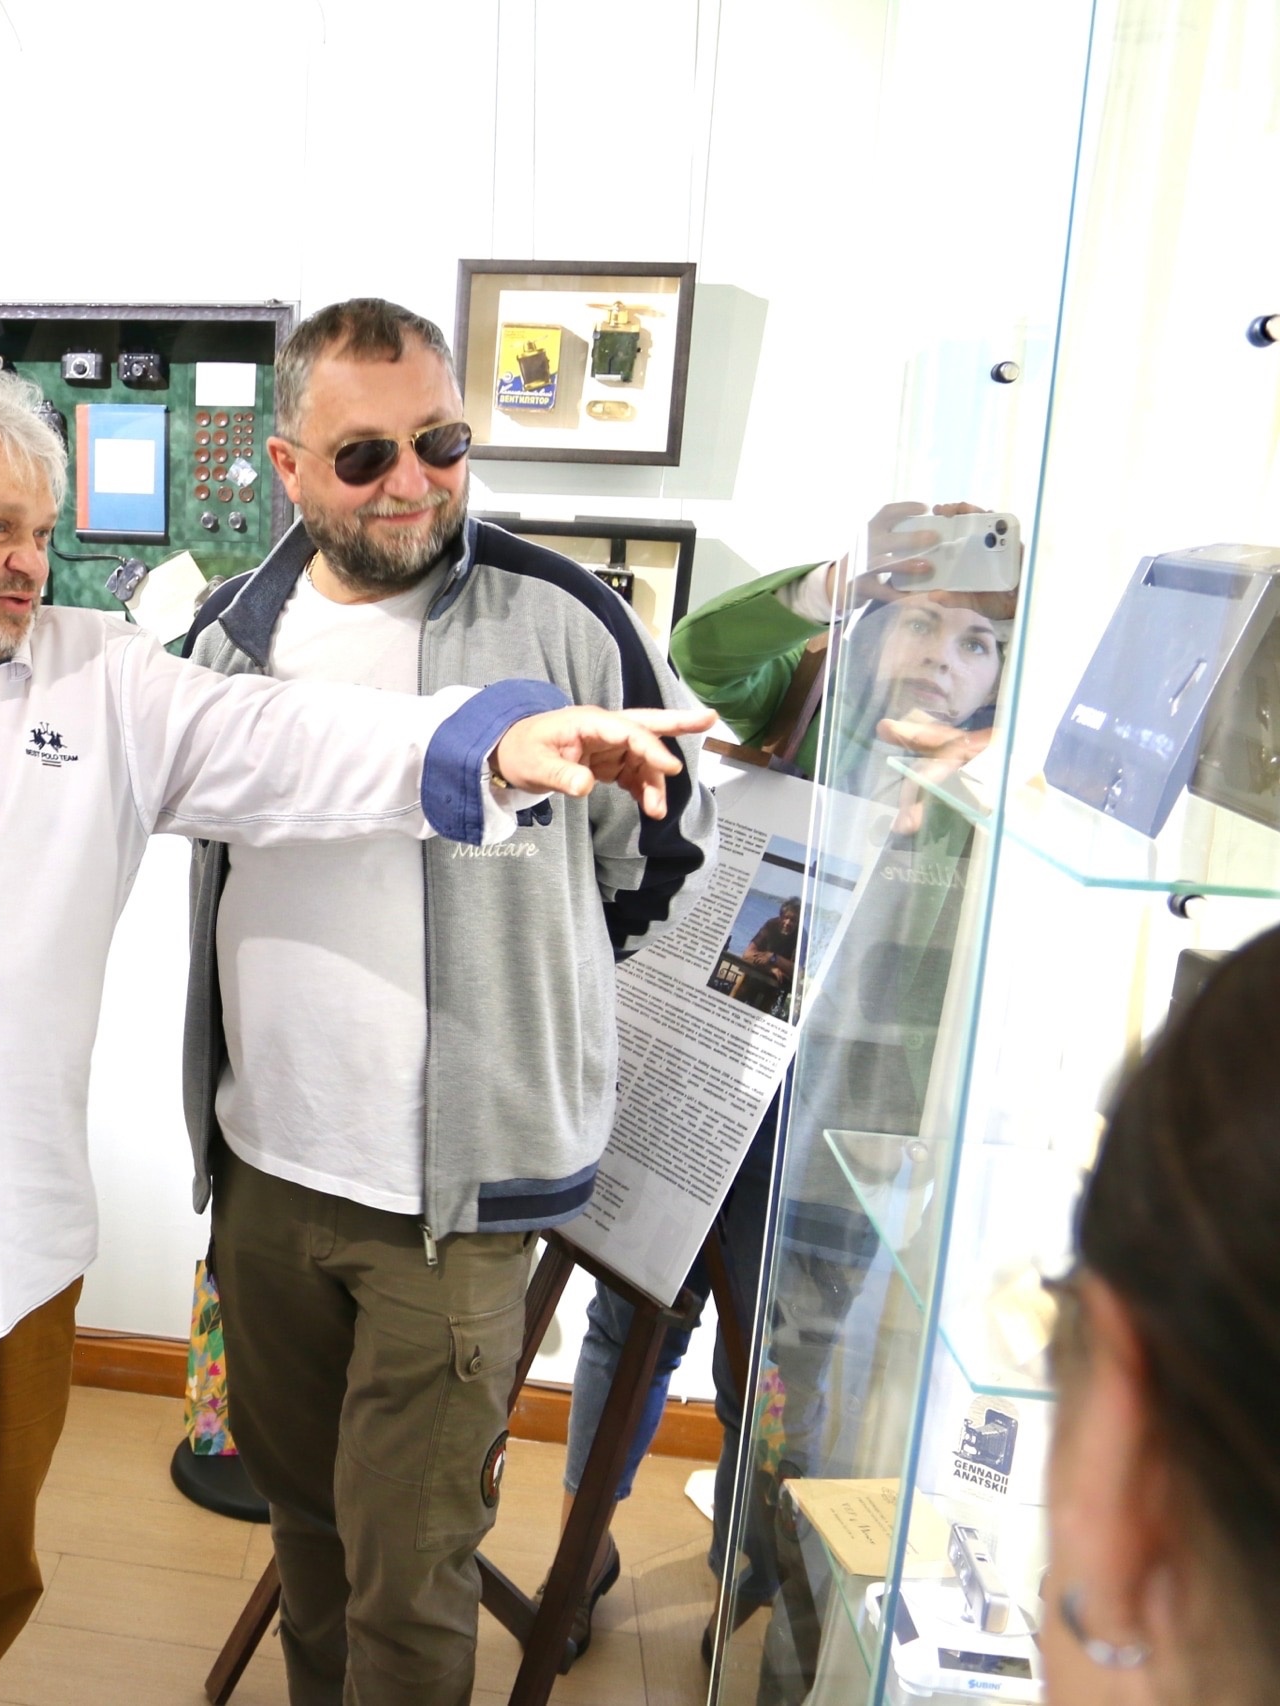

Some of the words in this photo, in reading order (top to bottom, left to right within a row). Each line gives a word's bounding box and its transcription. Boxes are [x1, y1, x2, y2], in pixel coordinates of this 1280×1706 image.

[25, 748, 40, 757] BEST
[41, 751, 58, 760] POLO
[953, 1469, 1007, 1494] ANATSKII
[954, 1459, 1009, 1486] GENNADII
